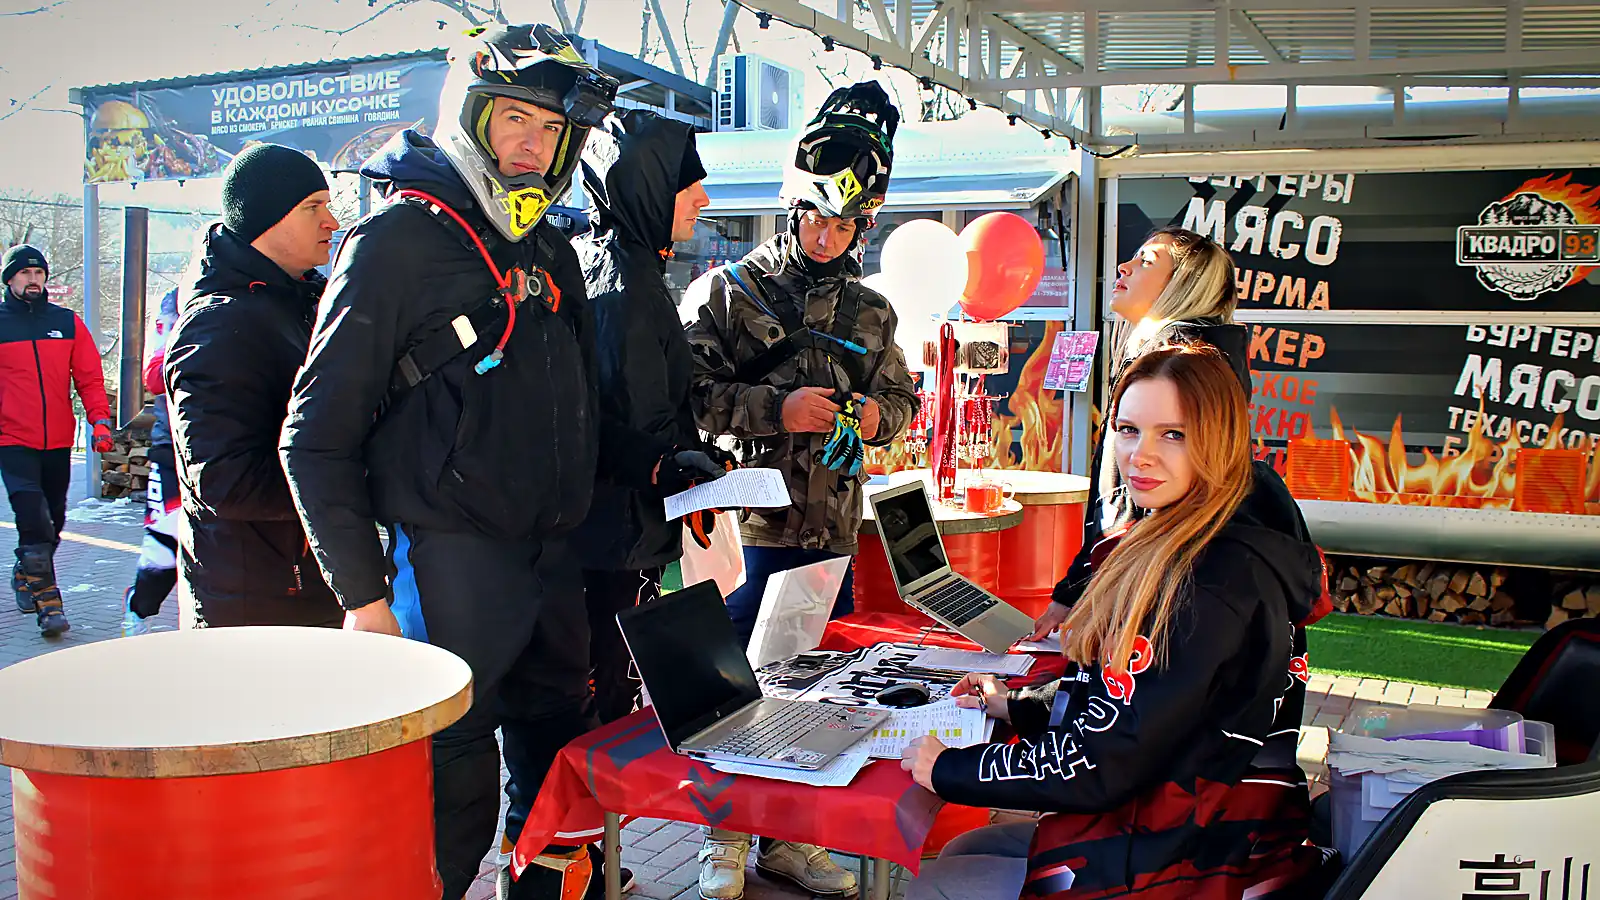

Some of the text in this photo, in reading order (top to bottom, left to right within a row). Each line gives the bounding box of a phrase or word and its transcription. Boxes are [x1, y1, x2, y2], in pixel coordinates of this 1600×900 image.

[211, 70, 401, 108] УДОВОЛЬСТВИЕ
[211, 93, 400, 124] В КАЖДОМ КУСОЧКЕ
[211, 110, 399, 135] МЯСО ИЗ СМОКЕРА БРИСКЕТ РВАНАЯ СВИНИНА ГОВЯДИНА
[1178, 197, 1343, 266] МЯСО
[1469, 235, 1595, 257] КВАДРО 93
[1453, 353, 1600, 421] МЯСО
